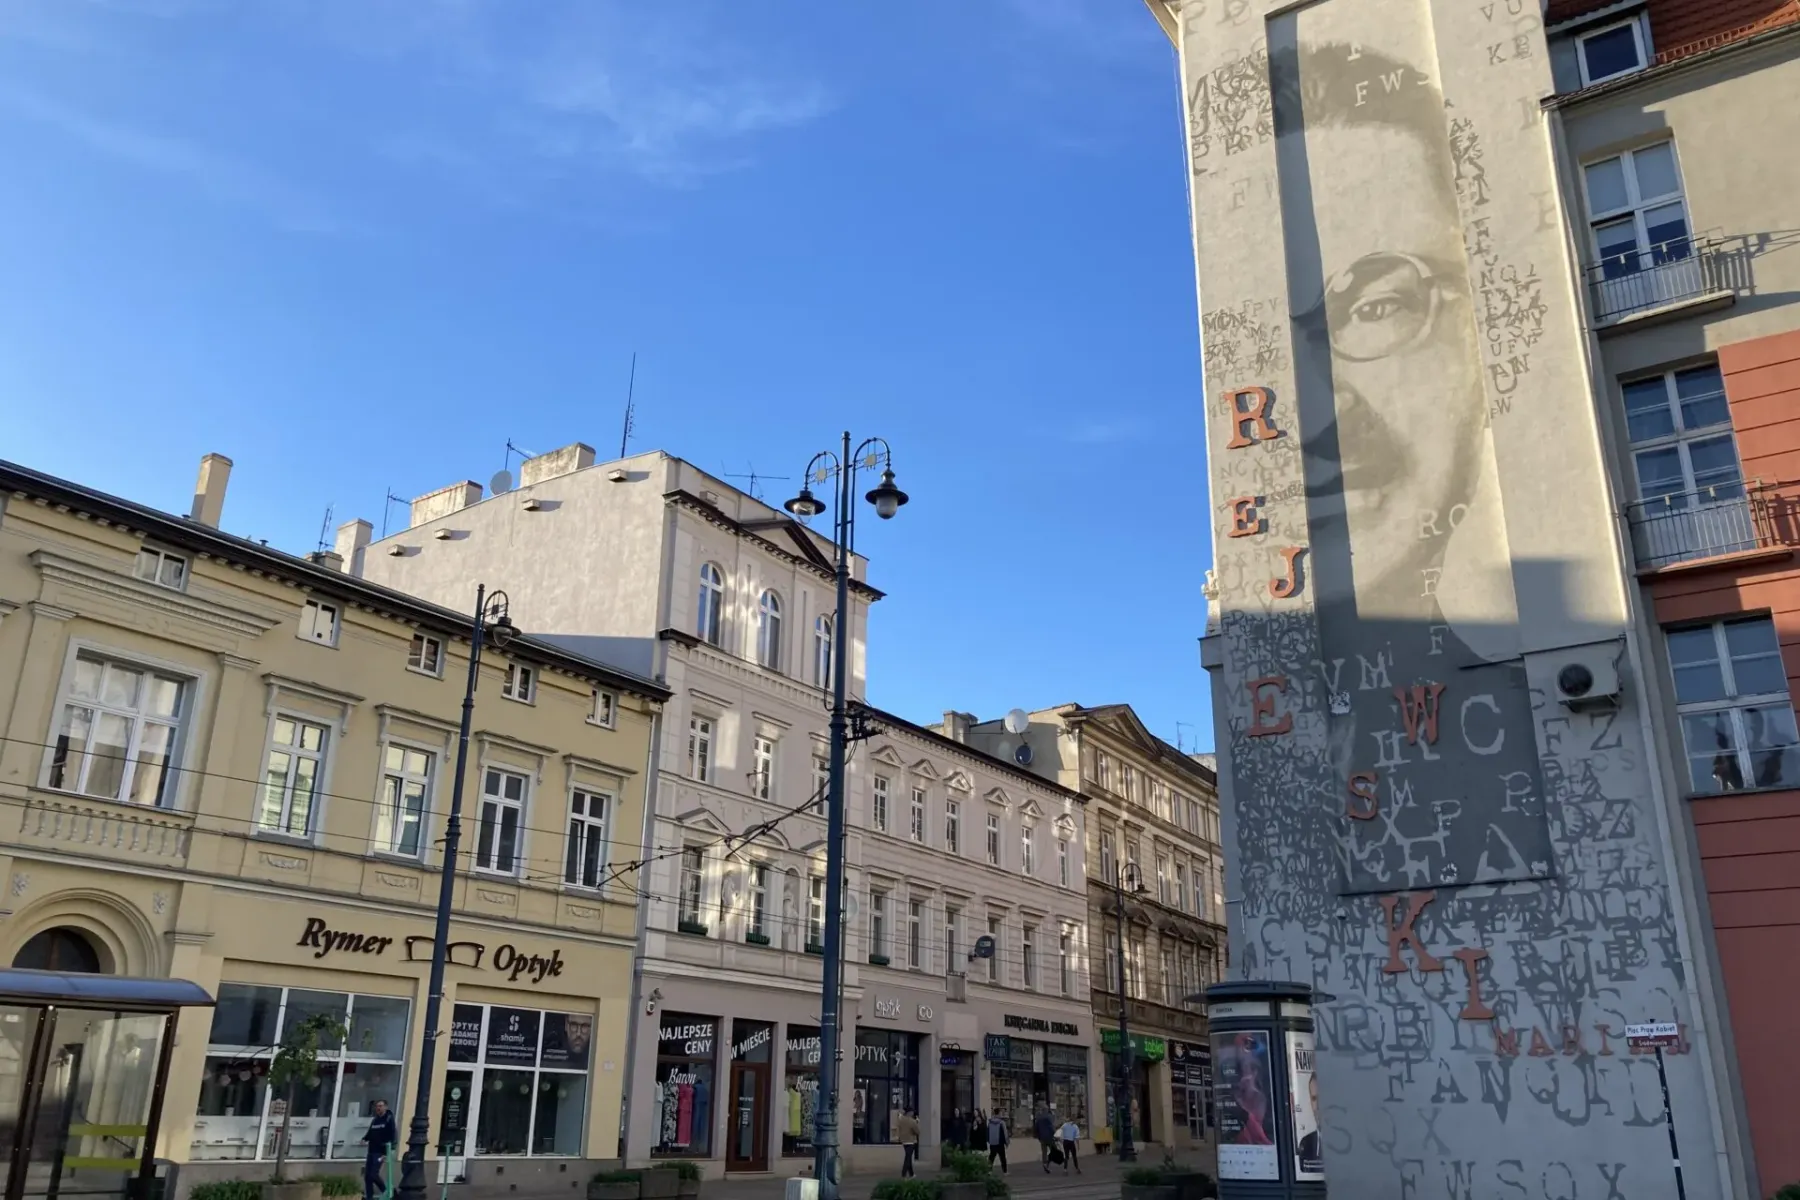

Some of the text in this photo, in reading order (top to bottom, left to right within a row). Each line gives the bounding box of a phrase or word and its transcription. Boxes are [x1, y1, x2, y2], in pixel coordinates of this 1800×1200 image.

[297, 917, 564, 984] Rymer Optyk
[500, 1033, 525, 1045] shamir
[658, 1024, 713, 1041] NAJLEPSZE
[740, 1027, 771, 1055] MIEŚCIE
[685, 1039, 712, 1055] CENY
[854, 1045, 888, 1062] OPTYK
